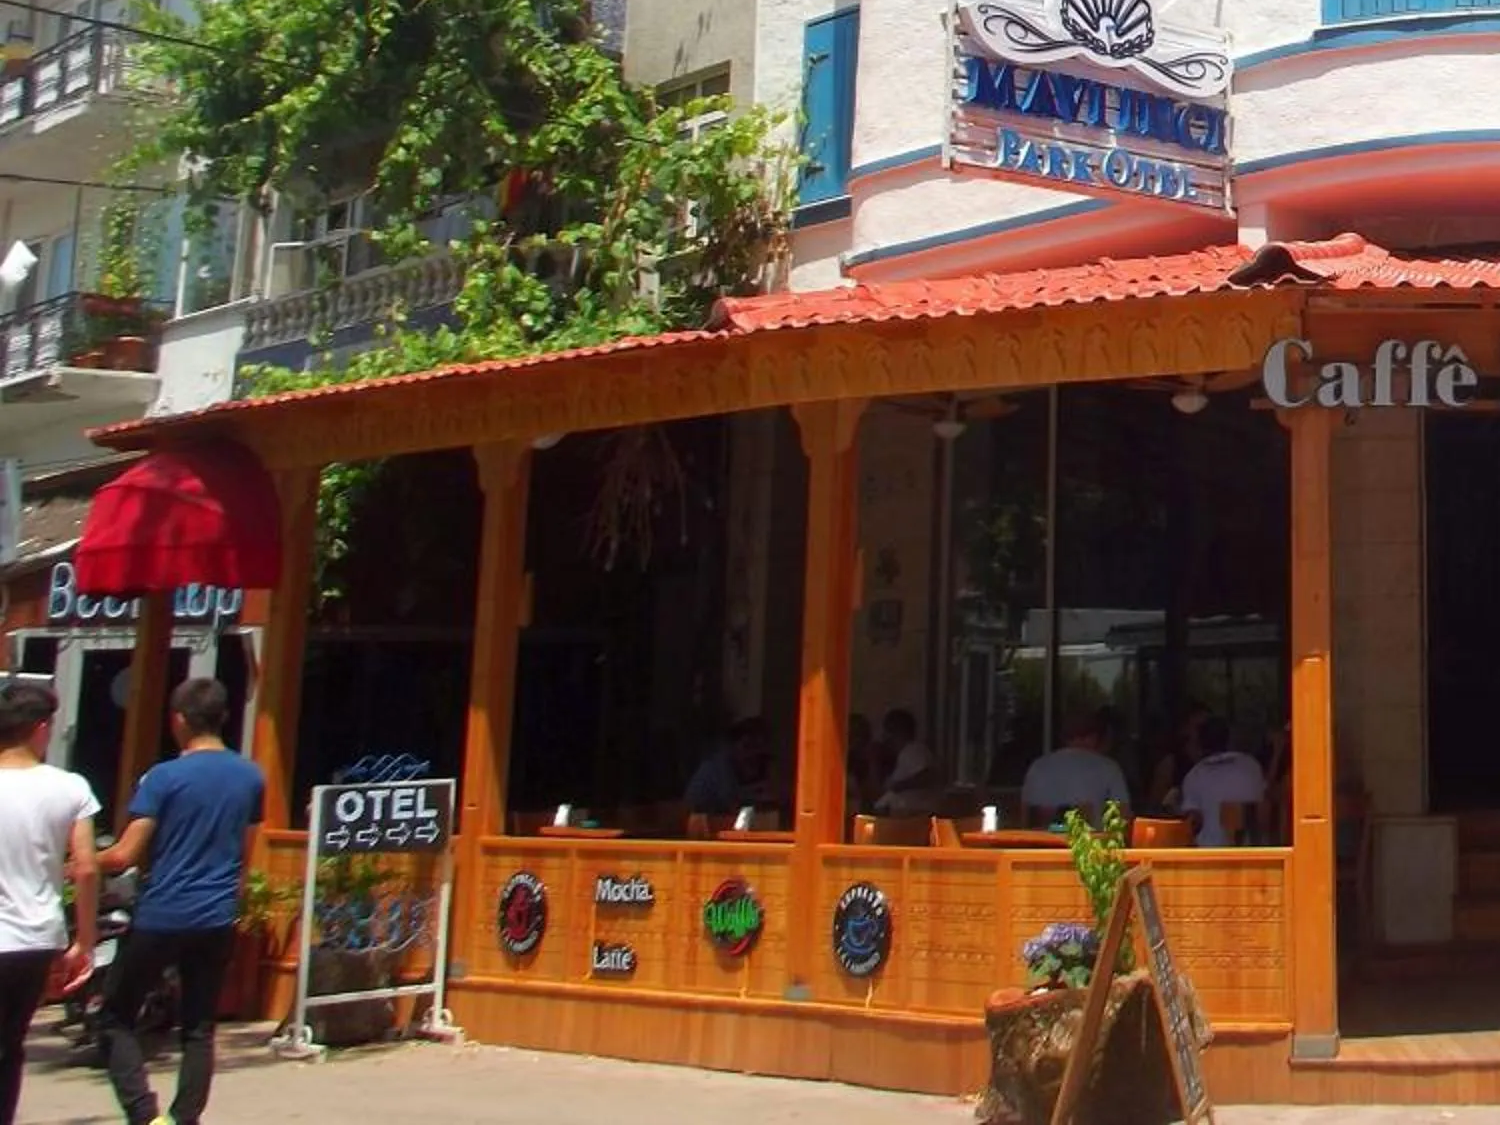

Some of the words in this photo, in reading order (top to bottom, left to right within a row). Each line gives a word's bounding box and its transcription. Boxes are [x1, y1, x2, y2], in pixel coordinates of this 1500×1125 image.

[994, 125, 1096, 183] PARK
[1102, 147, 1197, 201] OTEL
[335, 787, 438, 823] OTEL
[595, 878, 653, 901] Mocha
